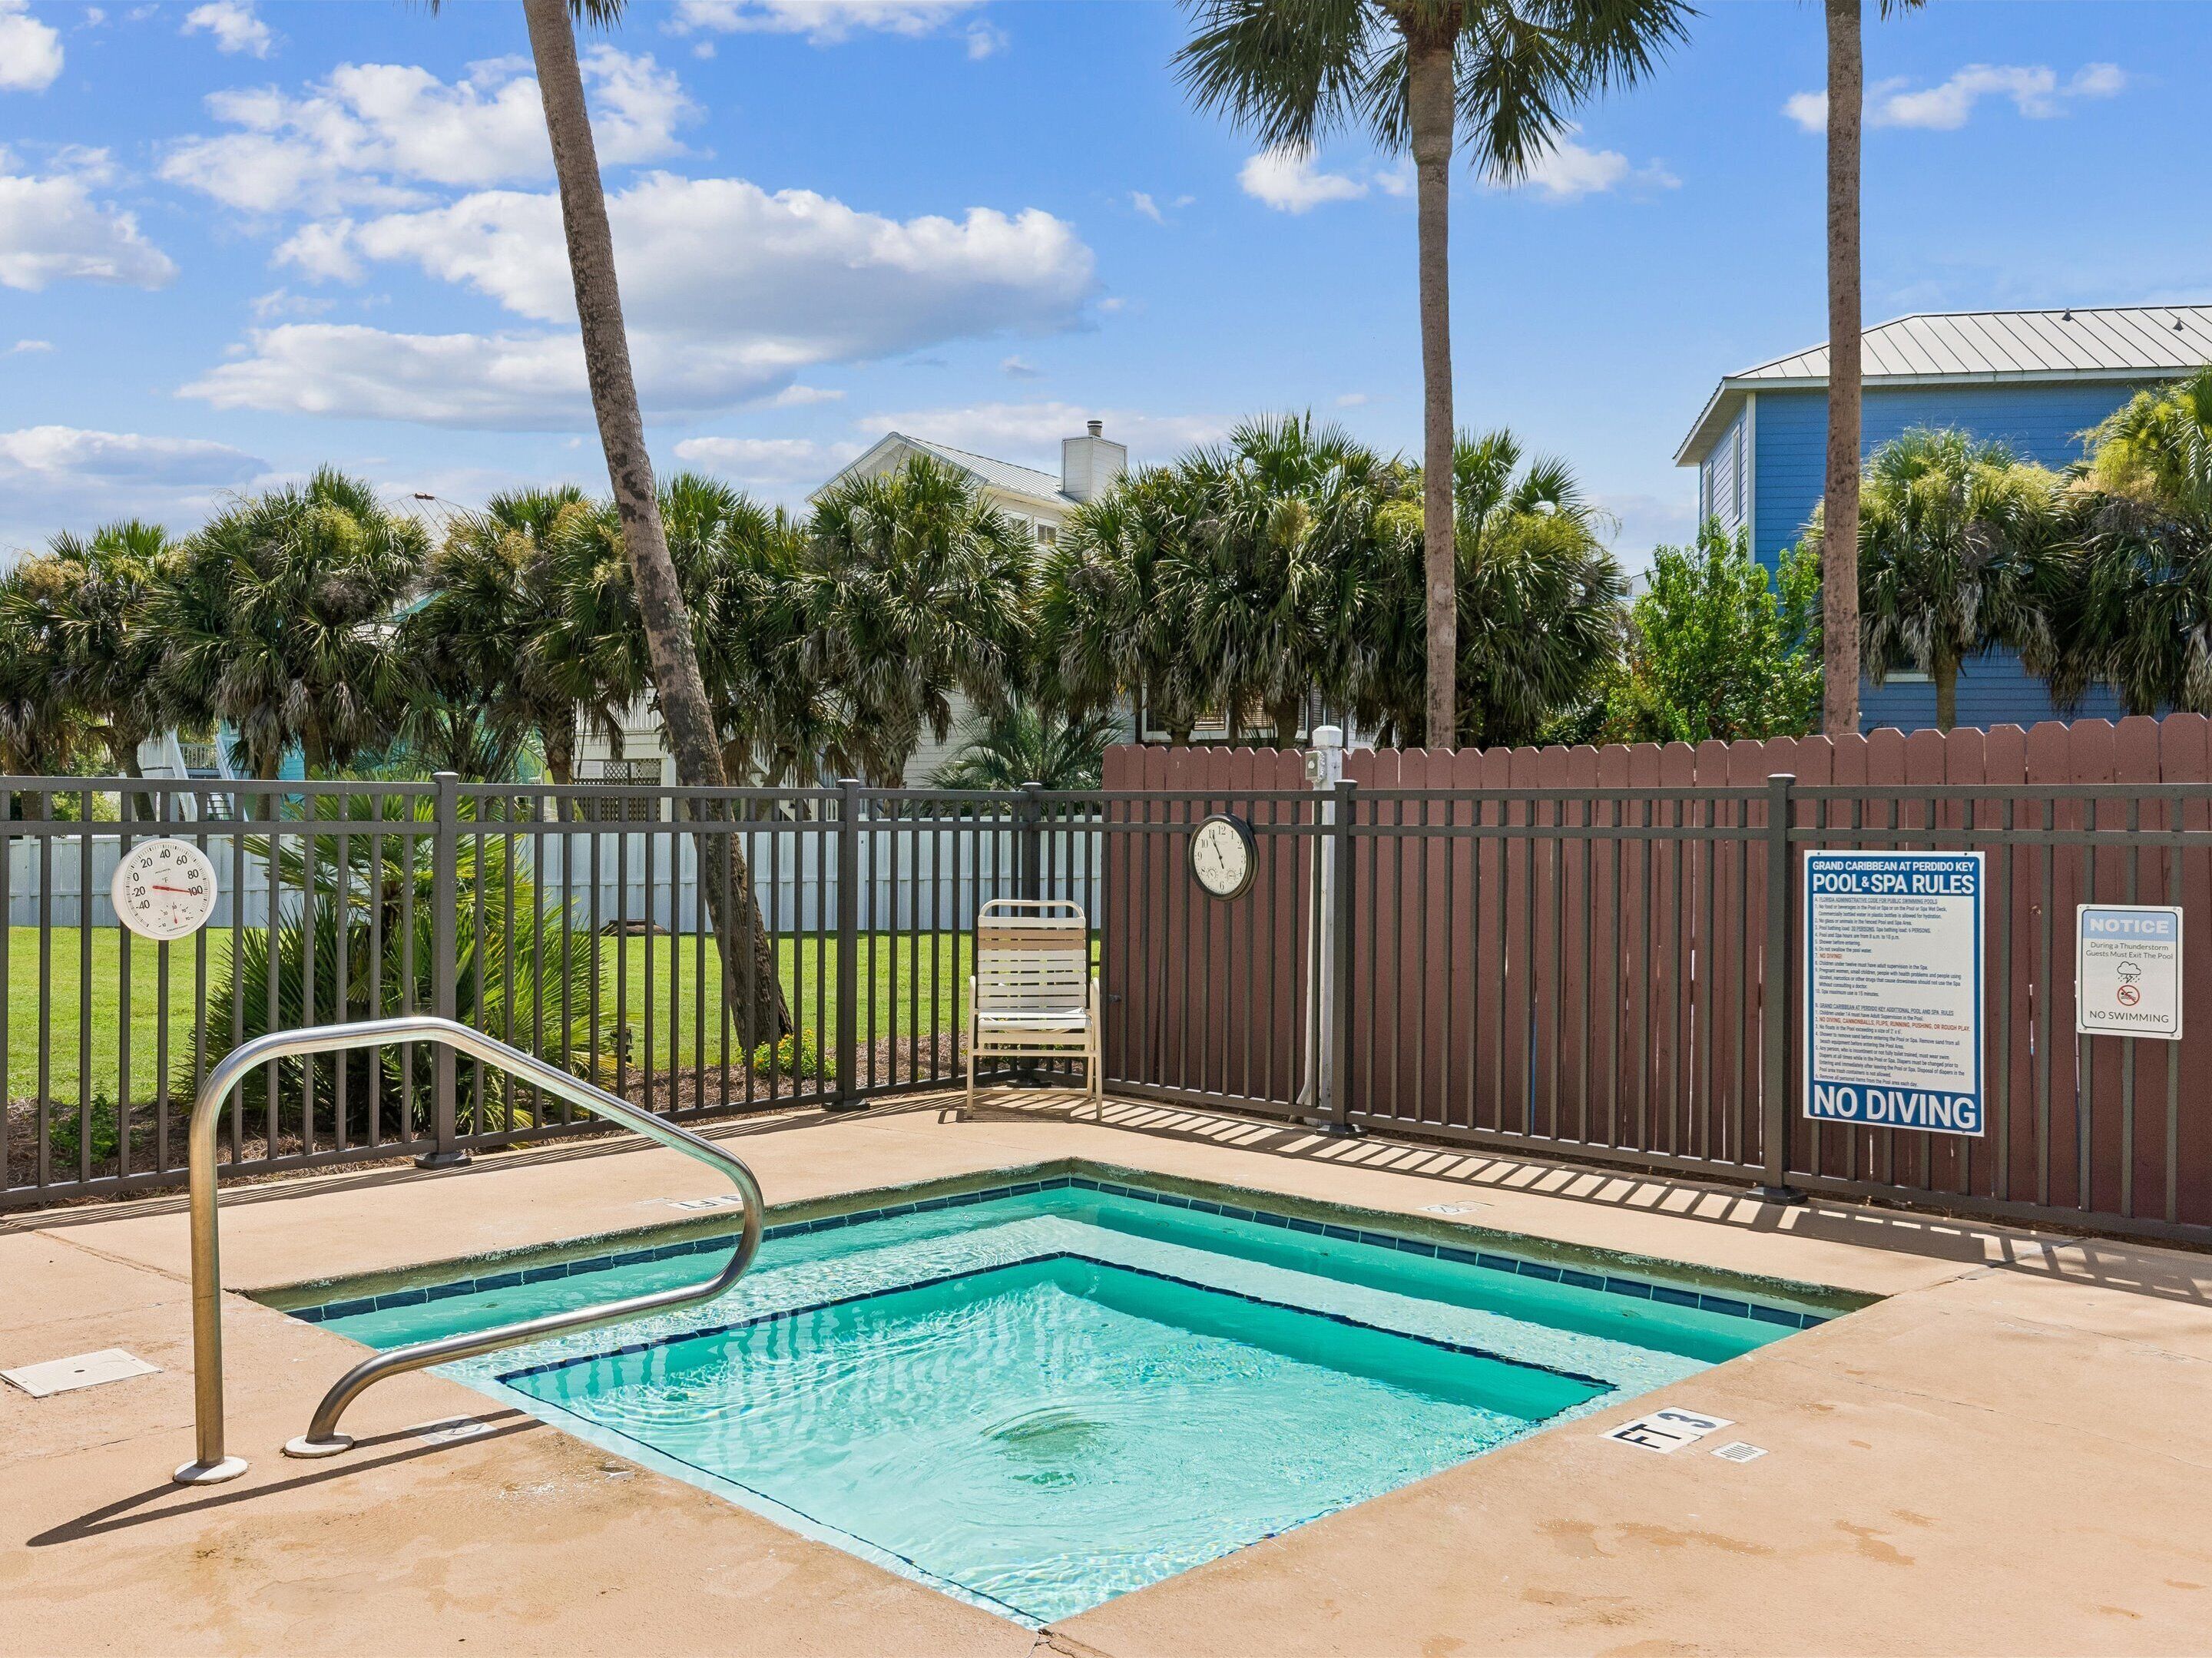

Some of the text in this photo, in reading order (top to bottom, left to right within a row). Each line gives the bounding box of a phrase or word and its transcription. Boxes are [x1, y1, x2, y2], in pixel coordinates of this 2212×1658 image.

[1218, 826, 1227, 835] 12
[1230, 830, 1233, 839] 1
[1201, 839, 1208, 848] 10
[1237, 841, 1243, 849] 2
[160, 849, 171, 859] 40
[1197, 852, 1202, 860] 9
[141, 858, 153, 869] 20
[177, 855, 187, 865] 60
[1241, 855, 1246, 864] 3
[1200, 866, 1205, 875] 8
[1237, 868, 1243, 876] 4
[1813, 862, 1974, 872] GRAND CARIBBEAN AT PERDIDO KEY
[133, 873, 139, 882] 0
[187, 869, 199, 879] 80
[1220, 881, 1224, 889] 6
[1912, 875, 1975, 894] RULES
[131, 886, 145, 897] -20
[188, 885, 203, 896] 100
[136, 900, 151, 909] -40
[2090, 918, 2169, 934] NOTICE
[2108, 1012, 2169, 1023] SWIMMING
[1814, 1085, 1975, 1128] NO DIVING
[1612, 1413, 1717, 1448] FT 3
